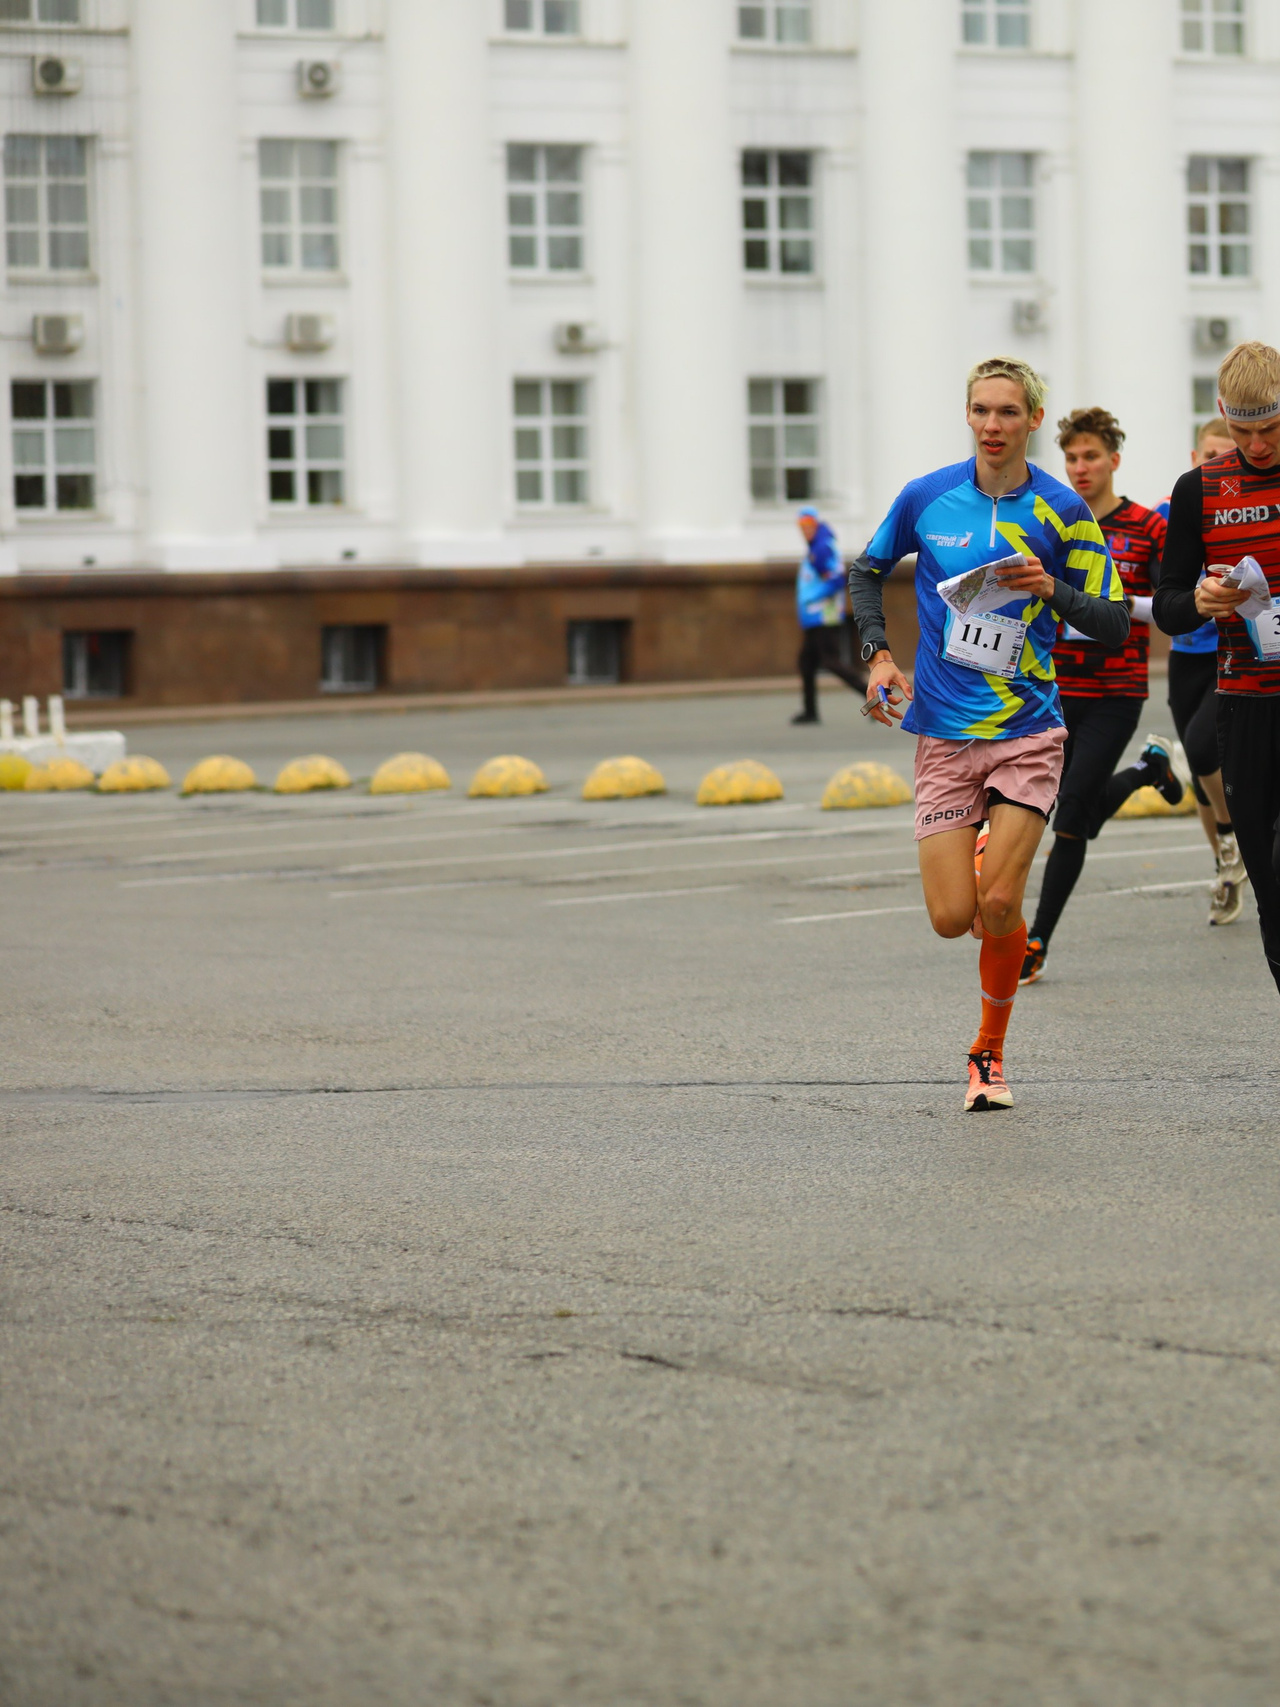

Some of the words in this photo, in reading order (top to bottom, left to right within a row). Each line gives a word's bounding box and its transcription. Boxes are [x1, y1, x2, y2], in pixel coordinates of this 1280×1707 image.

[1225, 401, 1279, 417] noname
[1214, 505, 1270, 525] NORD
[960, 624, 1002, 652] 11.1
